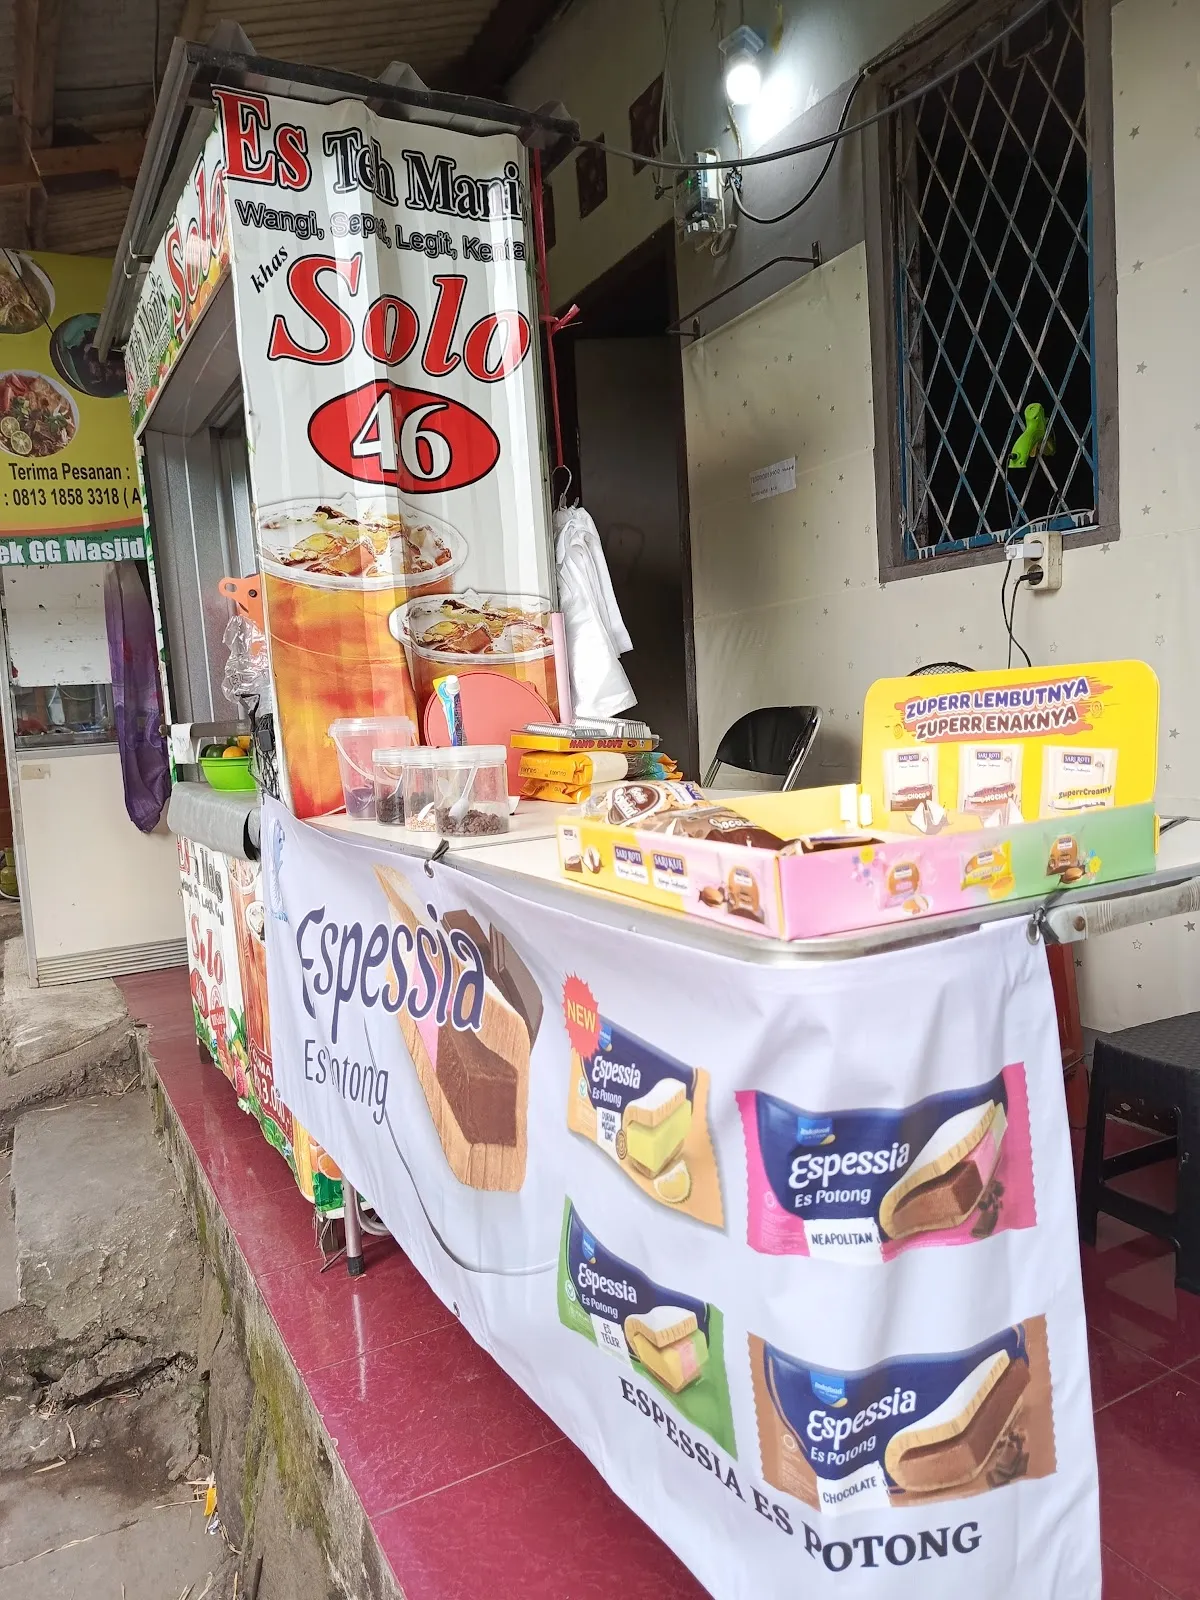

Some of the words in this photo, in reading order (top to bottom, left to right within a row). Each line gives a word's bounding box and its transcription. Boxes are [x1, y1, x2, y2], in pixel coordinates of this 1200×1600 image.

[211, 86, 312, 192] Es
[323, 126, 398, 206] Teh
[402, 149, 526, 224] Mani
[235, 199, 325, 241] Wangi,
[395, 224, 458, 260] Legit,
[462, 234, 526, 263] Kenta
[249, 246, 289, 294] khas
[267, 252, 531, 384] Solo
[351, 389, 453, 482] 46
[8, 463, 58, 480] Terima
[61, 462, 122, 480] Pesanan
[12, 488, 47, 506] 0813
[51, 488, 84, 505] 1858
[87, 487, 120, 505] 3318
[28, 540, 62, 562] GG
[65, 537, 146, 562] Masjid
[905, 697, 974, 721] ZUPERR
[974, 676, 1090, 710] LEMBUTNYA
[916, 713, 982, 740] ZUPERR
[984, 704, 1079, 734] ENAKNYA
[296, 903, 486, 1045] Espessia
[567, 998, 597, 1034] NEW
[304, 1038, 328, 1085] Es
[591, 1055, 642, 1090] Espessia
[592, 1087, 600, 1100] Es
[600, 1089, 622, 1108] Potong
[788, 1141, 912, 1190] Espessia
[794, 1193, 813, 1208] Es
[815, 1188, 872, 1206] Potong
[811, 1232, 874, 1246] NEAPOLITAN
[577, 1262, 638, 1305] Espessia
[581, 1293, 591, 1307] Es
[591, 1298, 619, 1320] Potong
[600, 1331, 621, 1349] TELER
[602, 1322, 612, 1335] ES
[806, 1386, 917, 1451] Espessia
[810, 1446, 826, 1463] Es
[826, 1435, 877, 1466] Potong
[618, 1375, 747, 1504] ESPESSIA
[749, 1484, 794, 1536] ES
[801, 1519, 983, 1573] POTONG
[822, 1475, 878, 1504] CHOCOLATE
